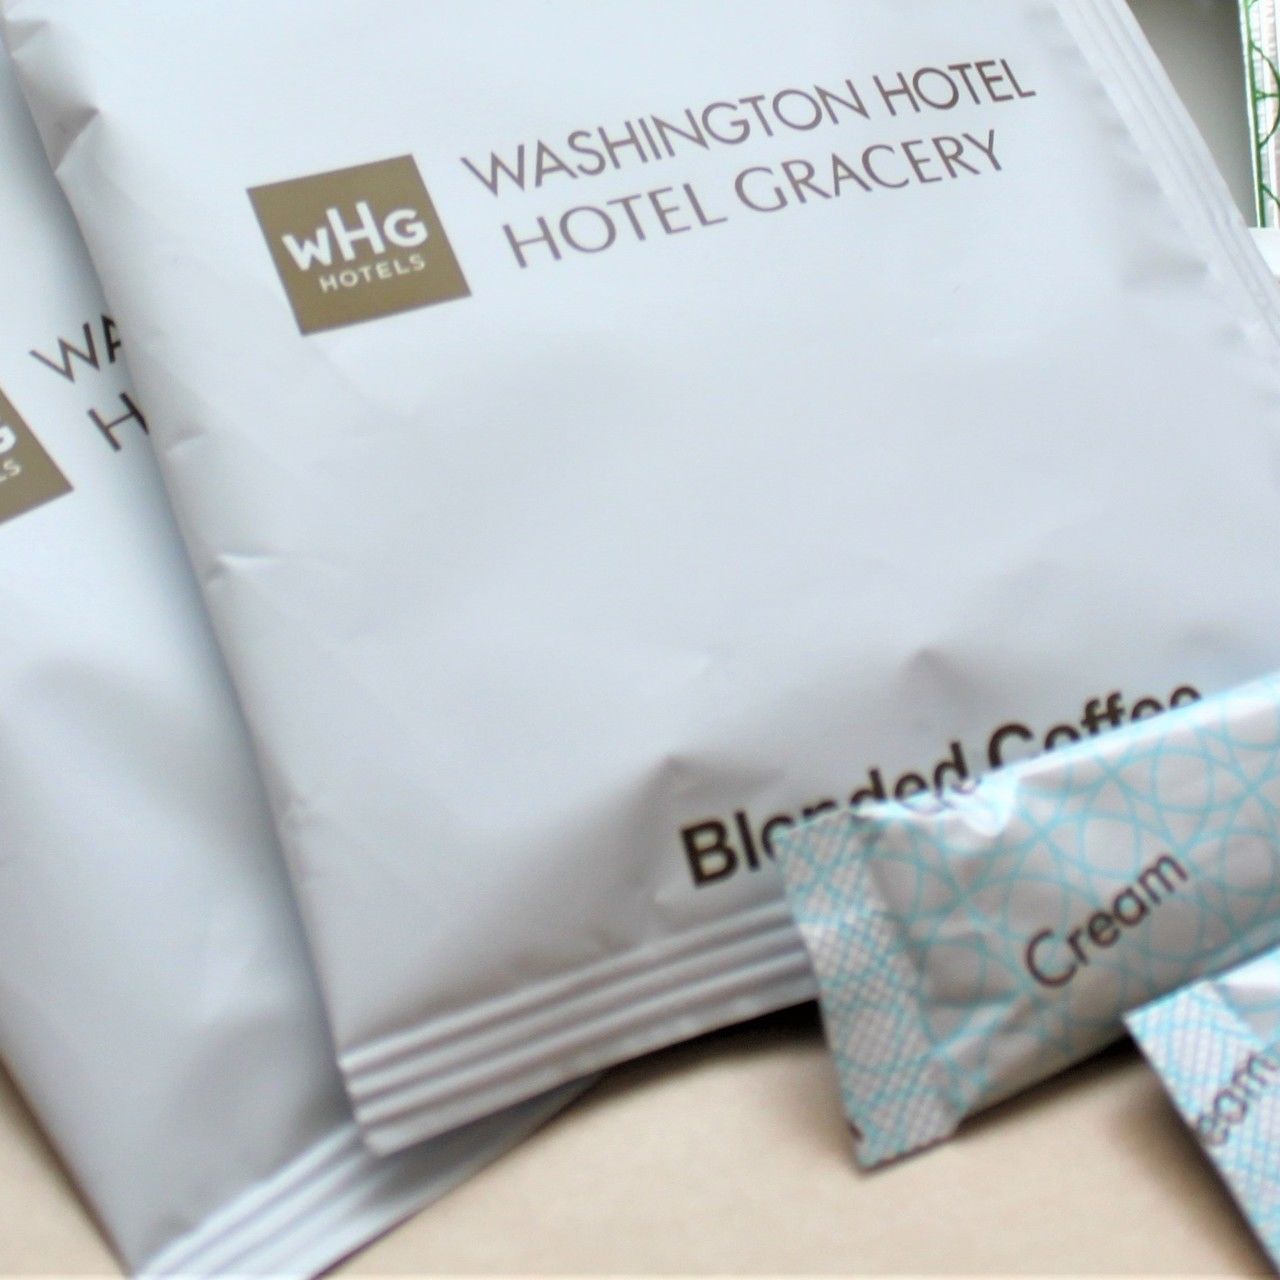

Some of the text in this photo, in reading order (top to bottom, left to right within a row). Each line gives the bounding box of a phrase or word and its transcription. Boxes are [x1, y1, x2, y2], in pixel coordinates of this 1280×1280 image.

[460, 58, 1037, 198] WASHINGTON HOTEL
[281, 200, 429, 271] WHG
[502, 128, 1004, 270] HOTEL GRACERY
[318, 253, 427, 293] HOTELS
[680, 741, 969, 888] Bleded
[1024, 852, 1190, 989] Cream
